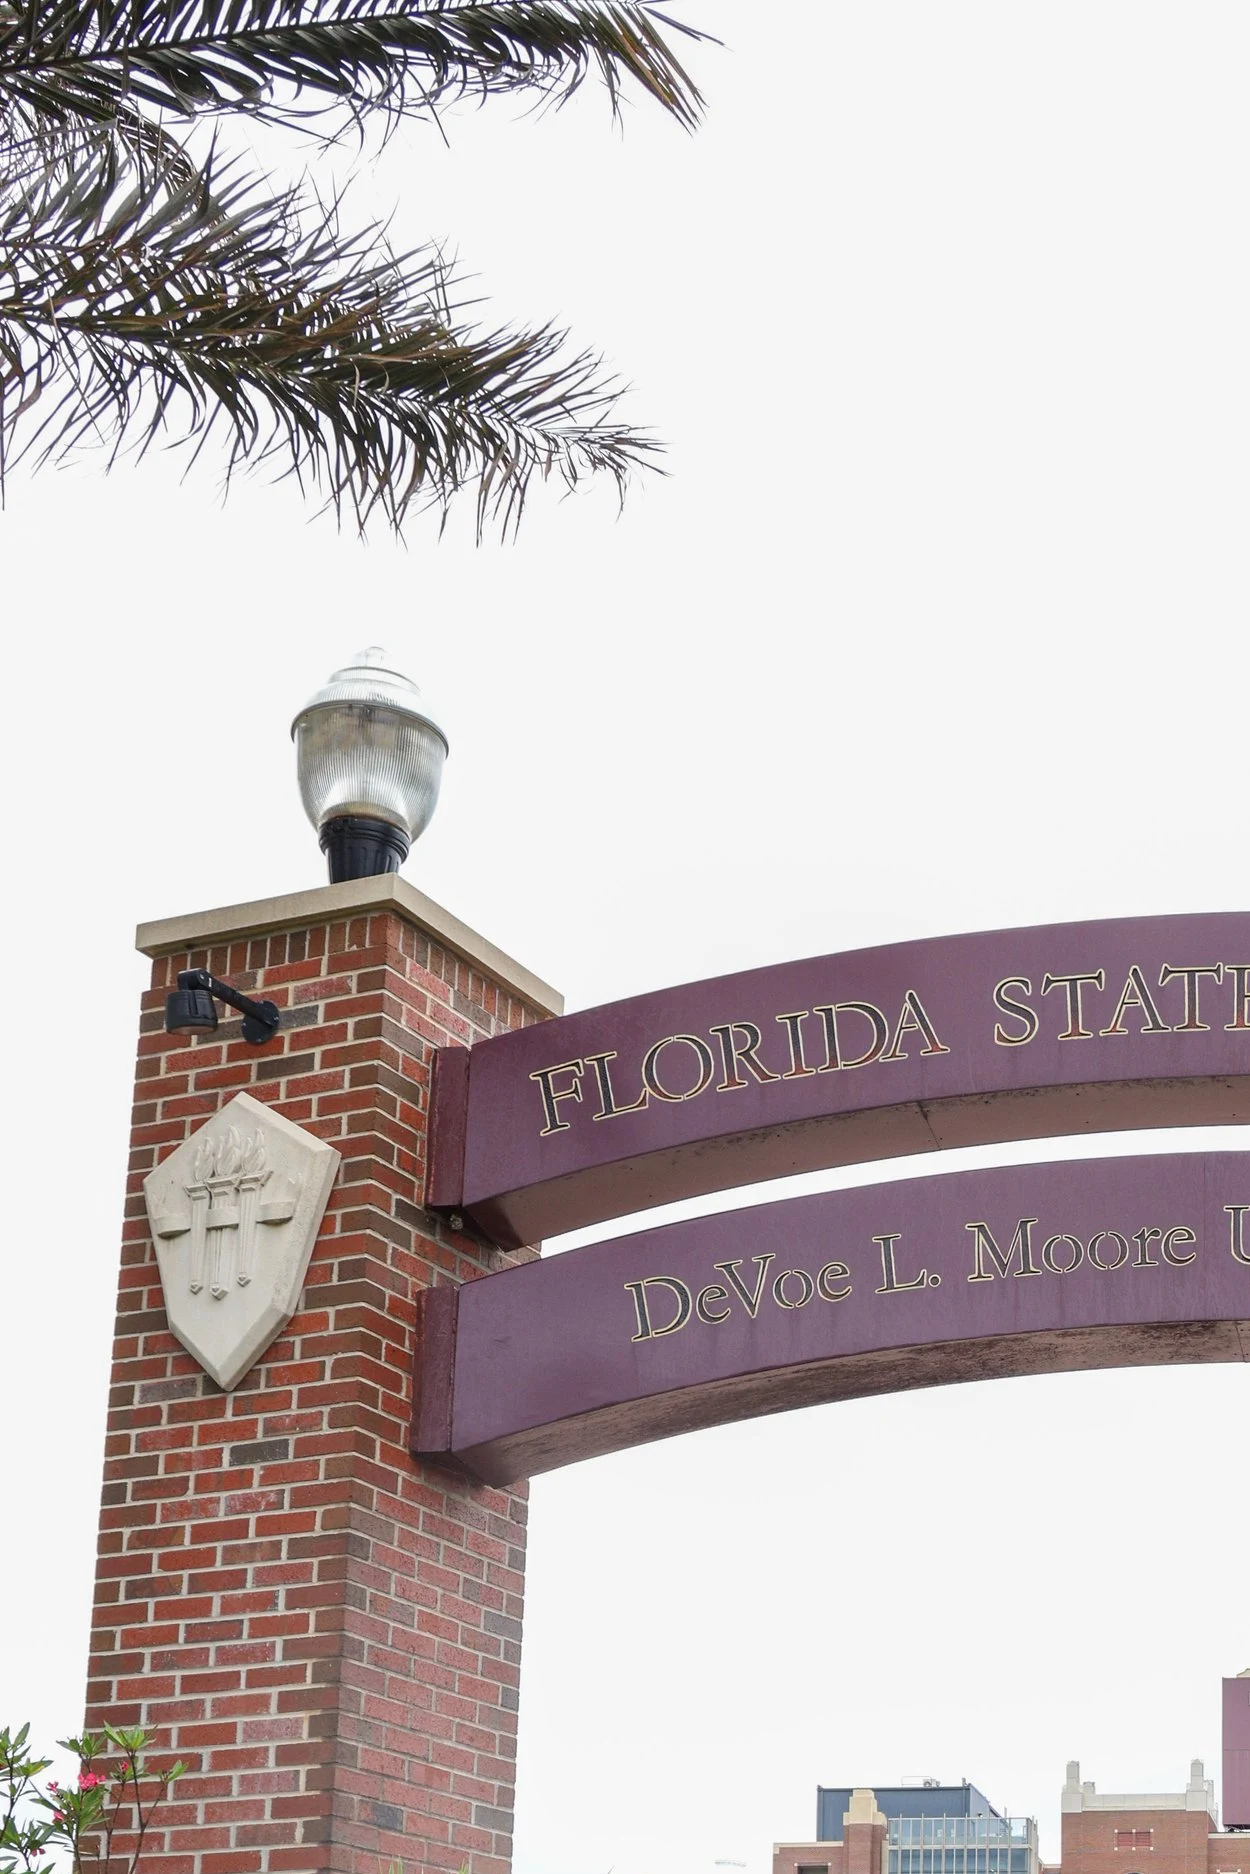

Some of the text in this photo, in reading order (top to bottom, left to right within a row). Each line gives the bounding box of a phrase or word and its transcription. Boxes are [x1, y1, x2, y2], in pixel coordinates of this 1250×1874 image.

[530, 990, 950, 1136] FLORIDA
[623, 1253, 852, 1342] DeVoe
[872, 1233, 941, 1293] L.
[966, 1217, 1197, 1283] Moore
